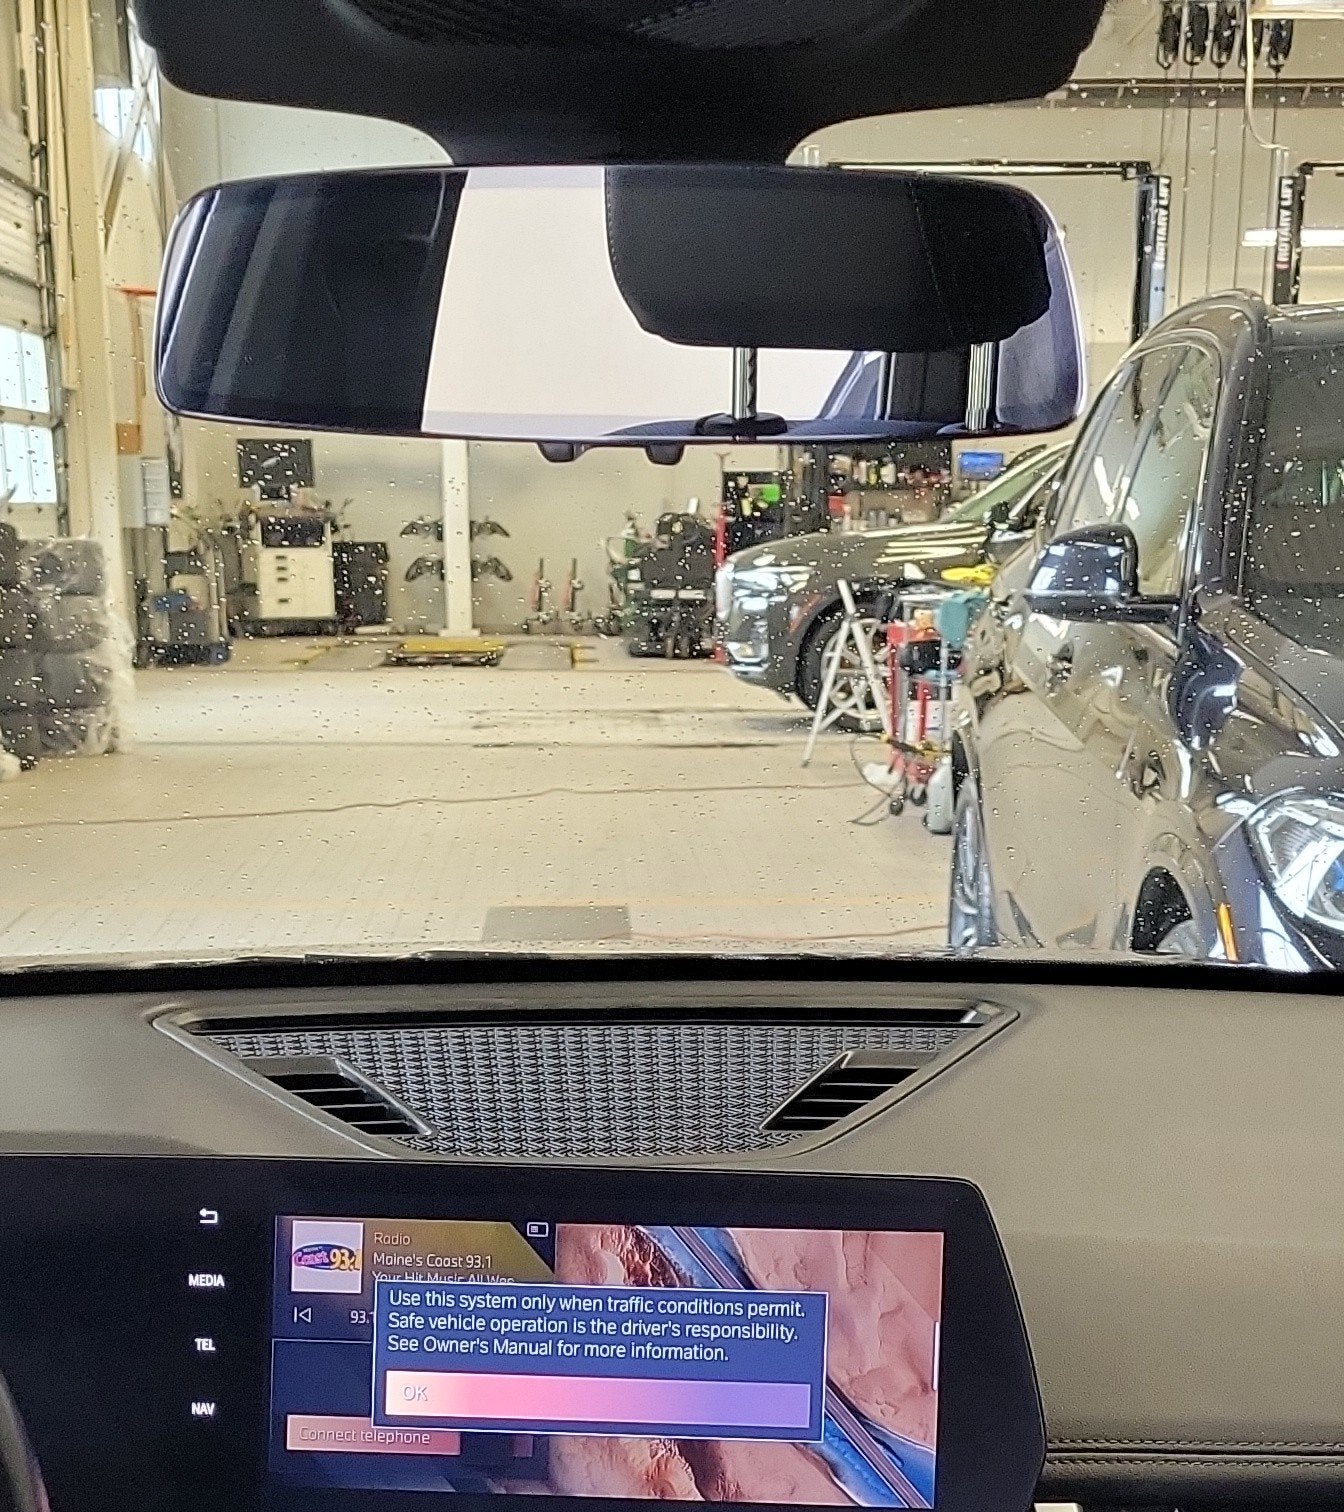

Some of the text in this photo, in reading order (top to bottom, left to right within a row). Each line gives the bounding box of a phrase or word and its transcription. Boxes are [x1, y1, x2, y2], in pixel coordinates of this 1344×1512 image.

[374, 1232, 411, 1246] Radio
[373, 1252, 492, 1269] Maine's Coast 93.1
[188, 1273, 225, 1287] MEDIA
[389, 1290, 805, 1319] Use this system only when traffic conditions permit.
[388, 1312, 798, 1343] Safe vehicle operation is the driver's responsibility.
[194, 1337, 216, 1351] TEL
[387, 1335, 729, 1361] See Owner's Manual for more information.
[403, 1386, 428, 1401] OK
[191, 1402, 216, 1415] NAV
[299, 1427, 431, 1445] Connect telephone
